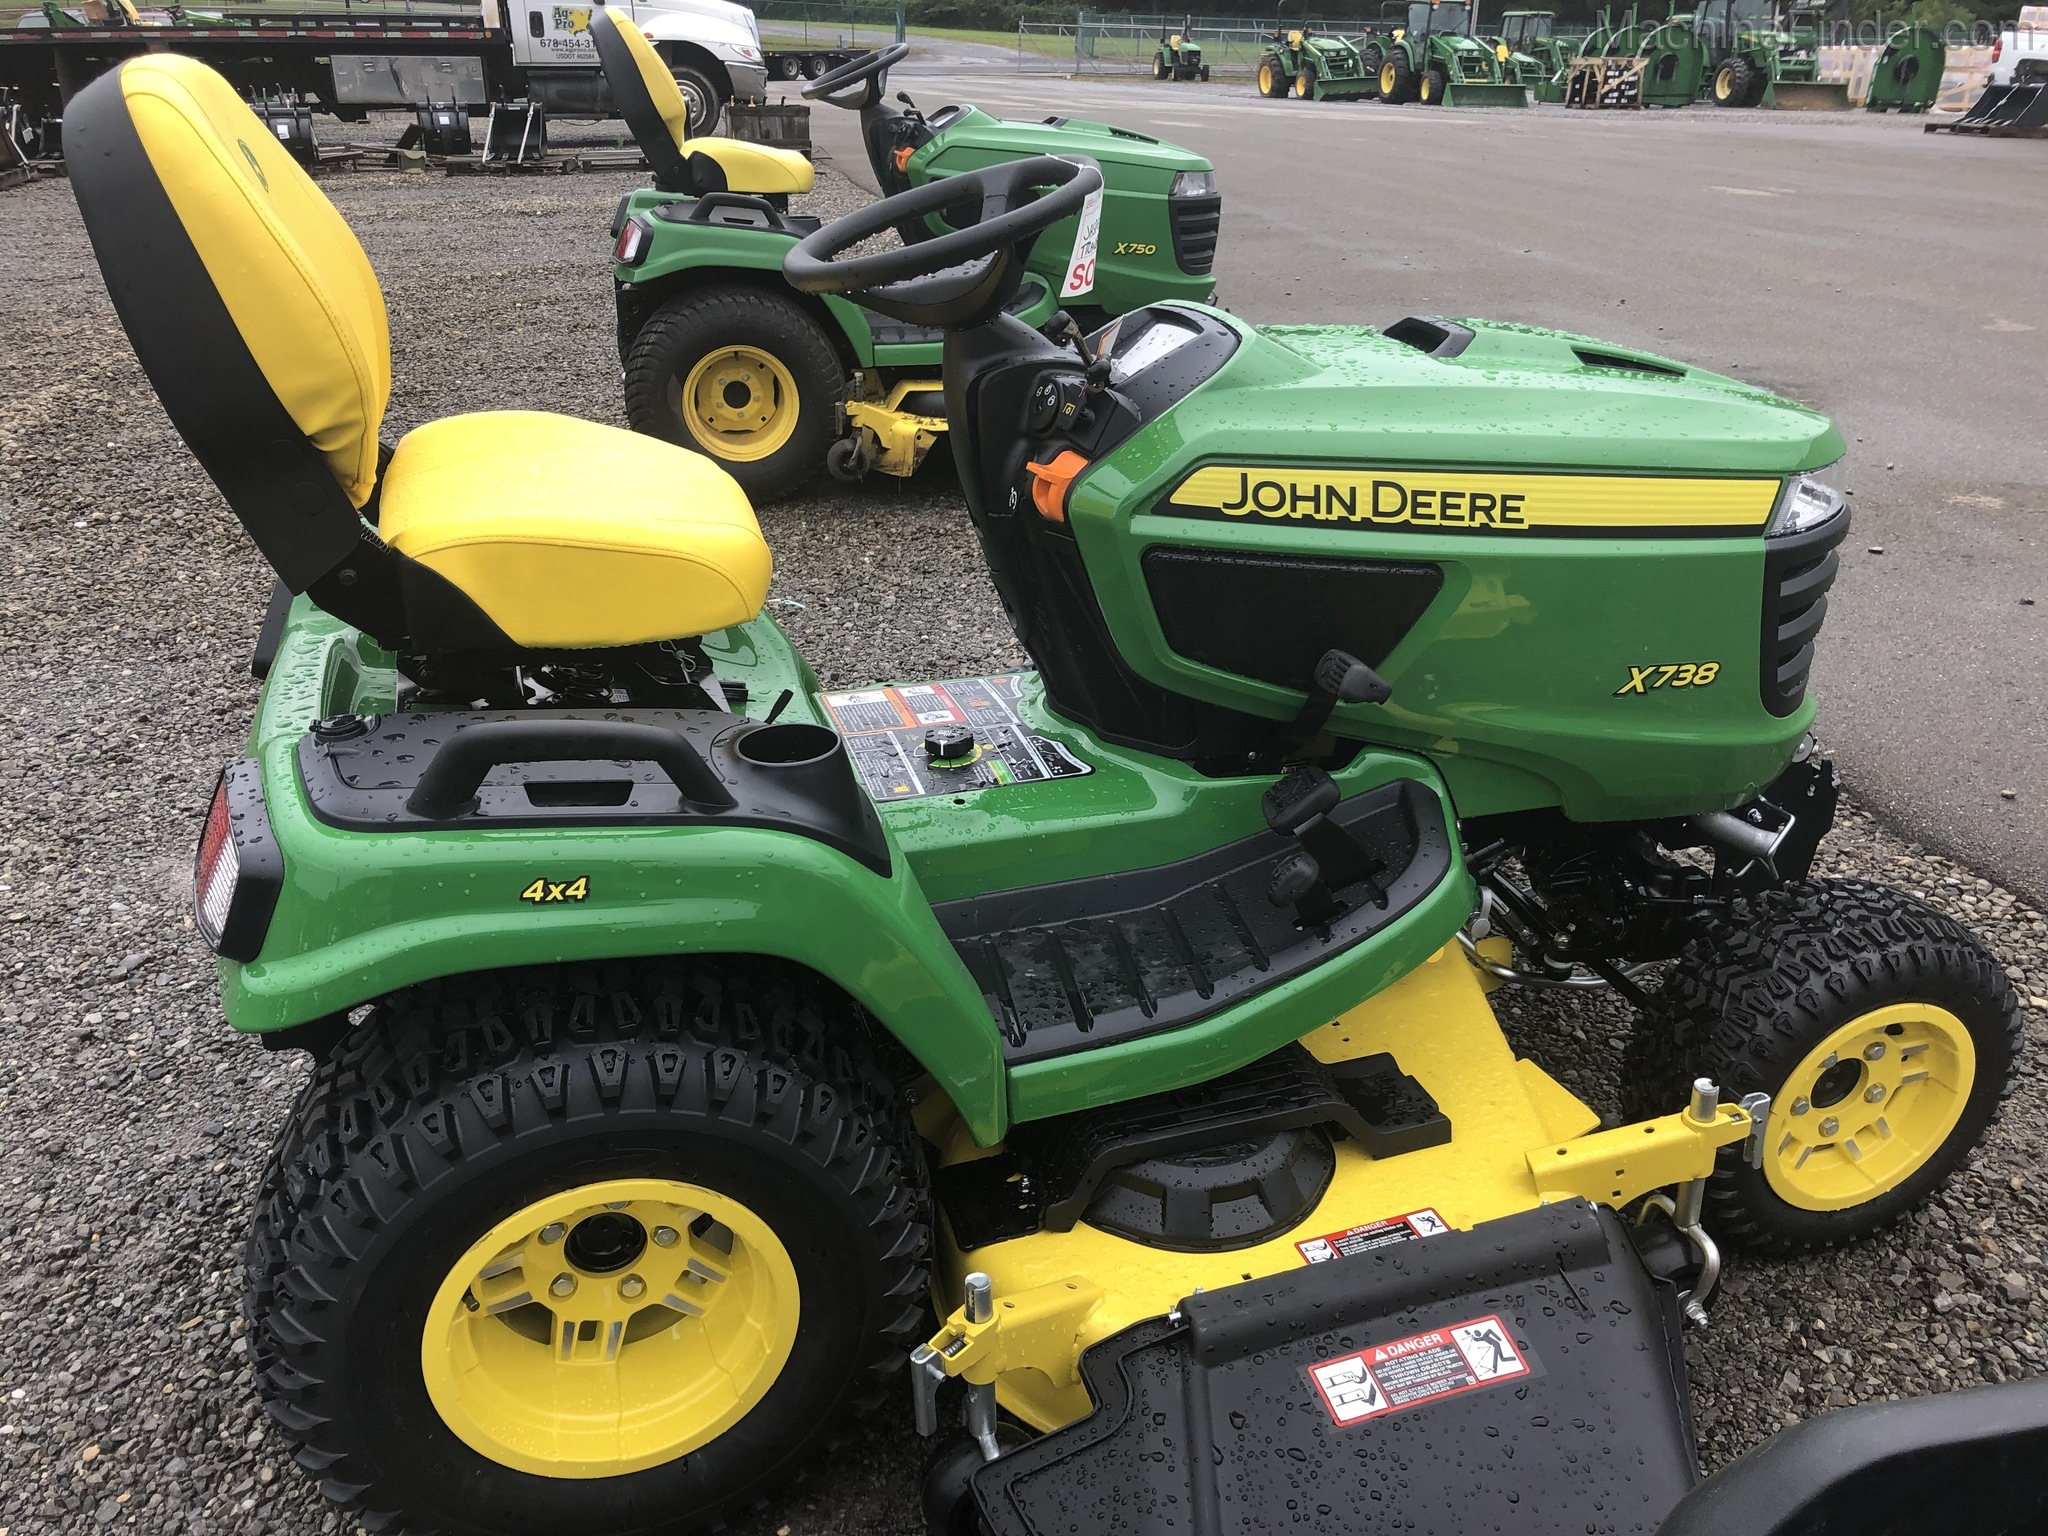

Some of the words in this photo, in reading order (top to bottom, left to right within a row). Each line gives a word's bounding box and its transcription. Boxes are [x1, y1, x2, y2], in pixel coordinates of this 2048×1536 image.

[554, 7, 573, 20] Ag-
[554, 18, 575, 29] Pro
[1112, 241, 1157, 256] X750
[1612, 660, 1721, 695] X738
[520, 875, 590, 905] 4x4
[1353, 1221, 1388, 1233] DANGER
[1387, 1333, 1443, 1357] DANGER
[1385, 1353, 1419, 1366] ROTATING
[1420, 1347, 1442, 1357] BLADE
[1390, 1368, 1420, 1379] THROWN
[1421, 1360, 1451, 1371] OBJECTS
